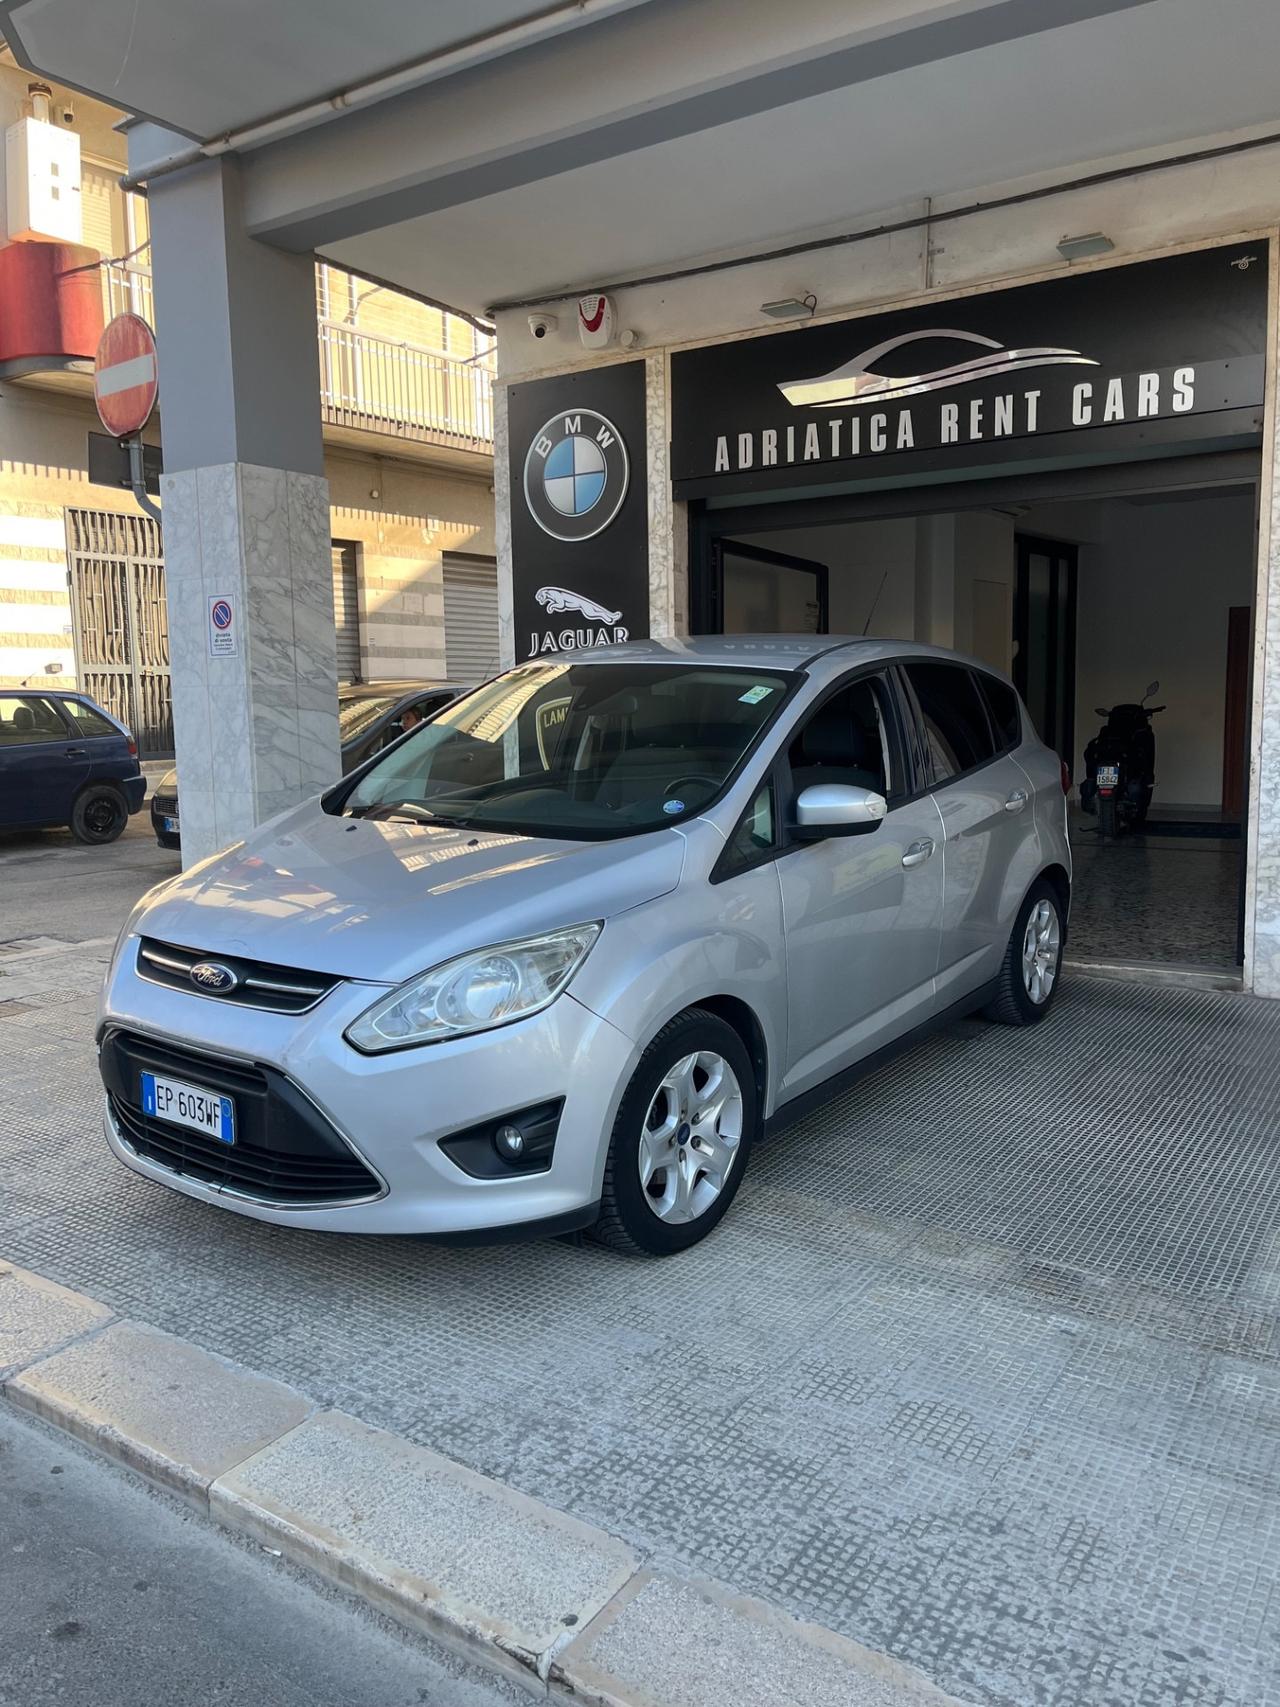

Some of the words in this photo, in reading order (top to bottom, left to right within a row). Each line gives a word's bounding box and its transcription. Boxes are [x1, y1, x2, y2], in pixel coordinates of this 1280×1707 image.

[534, 415, 615, 459] BMW
[714, 409, 915, 472] ADRIATICA
[940, 389, 1041, 444] RENT
[1072, 367, 1196, 426] CARS
[528, 626, 629, 657] JAGUAR
[543, 707, 569, 728] LAM
[197, 966, 224, 987] Ford
[156, 1085, 174, 1112] EP
[178, 1091, 220, 1128] 603WF
